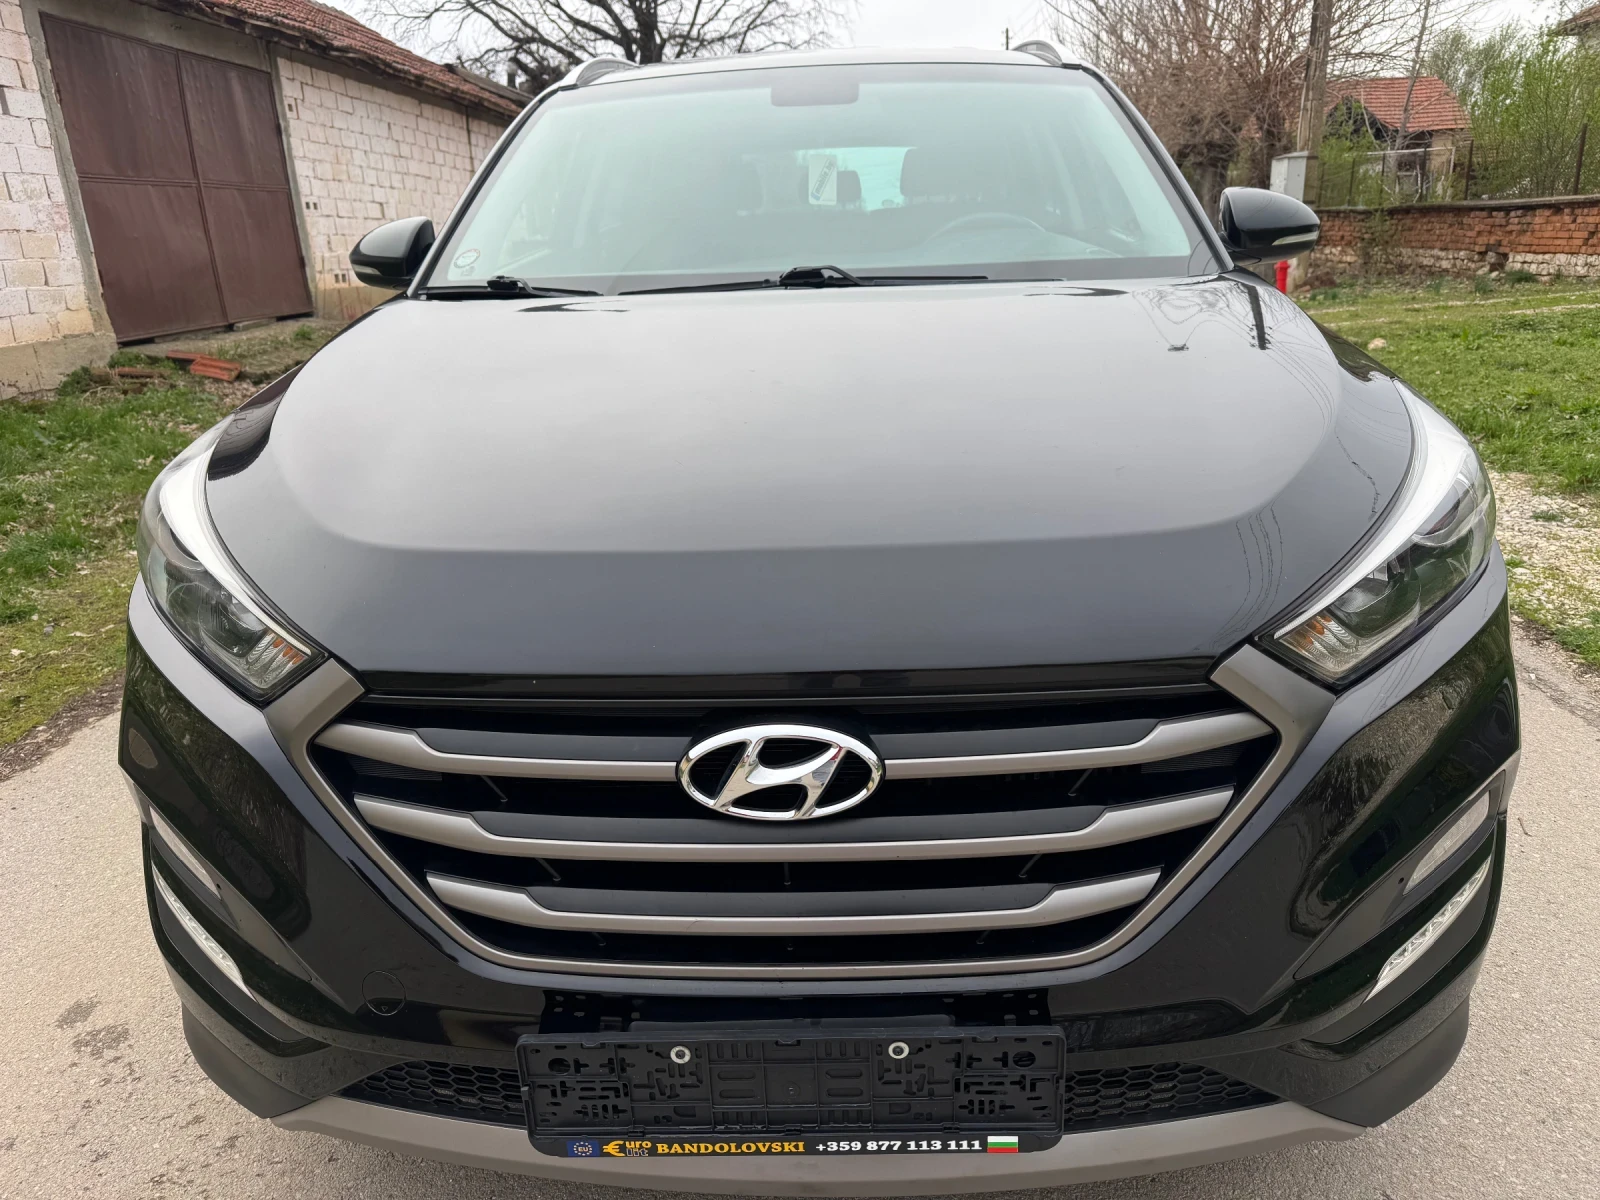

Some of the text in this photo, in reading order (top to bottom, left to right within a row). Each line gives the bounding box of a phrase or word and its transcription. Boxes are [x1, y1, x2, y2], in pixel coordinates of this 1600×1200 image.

[656, 1140, 982, 1154] BANDOLOVSKI +359 877 113 111
